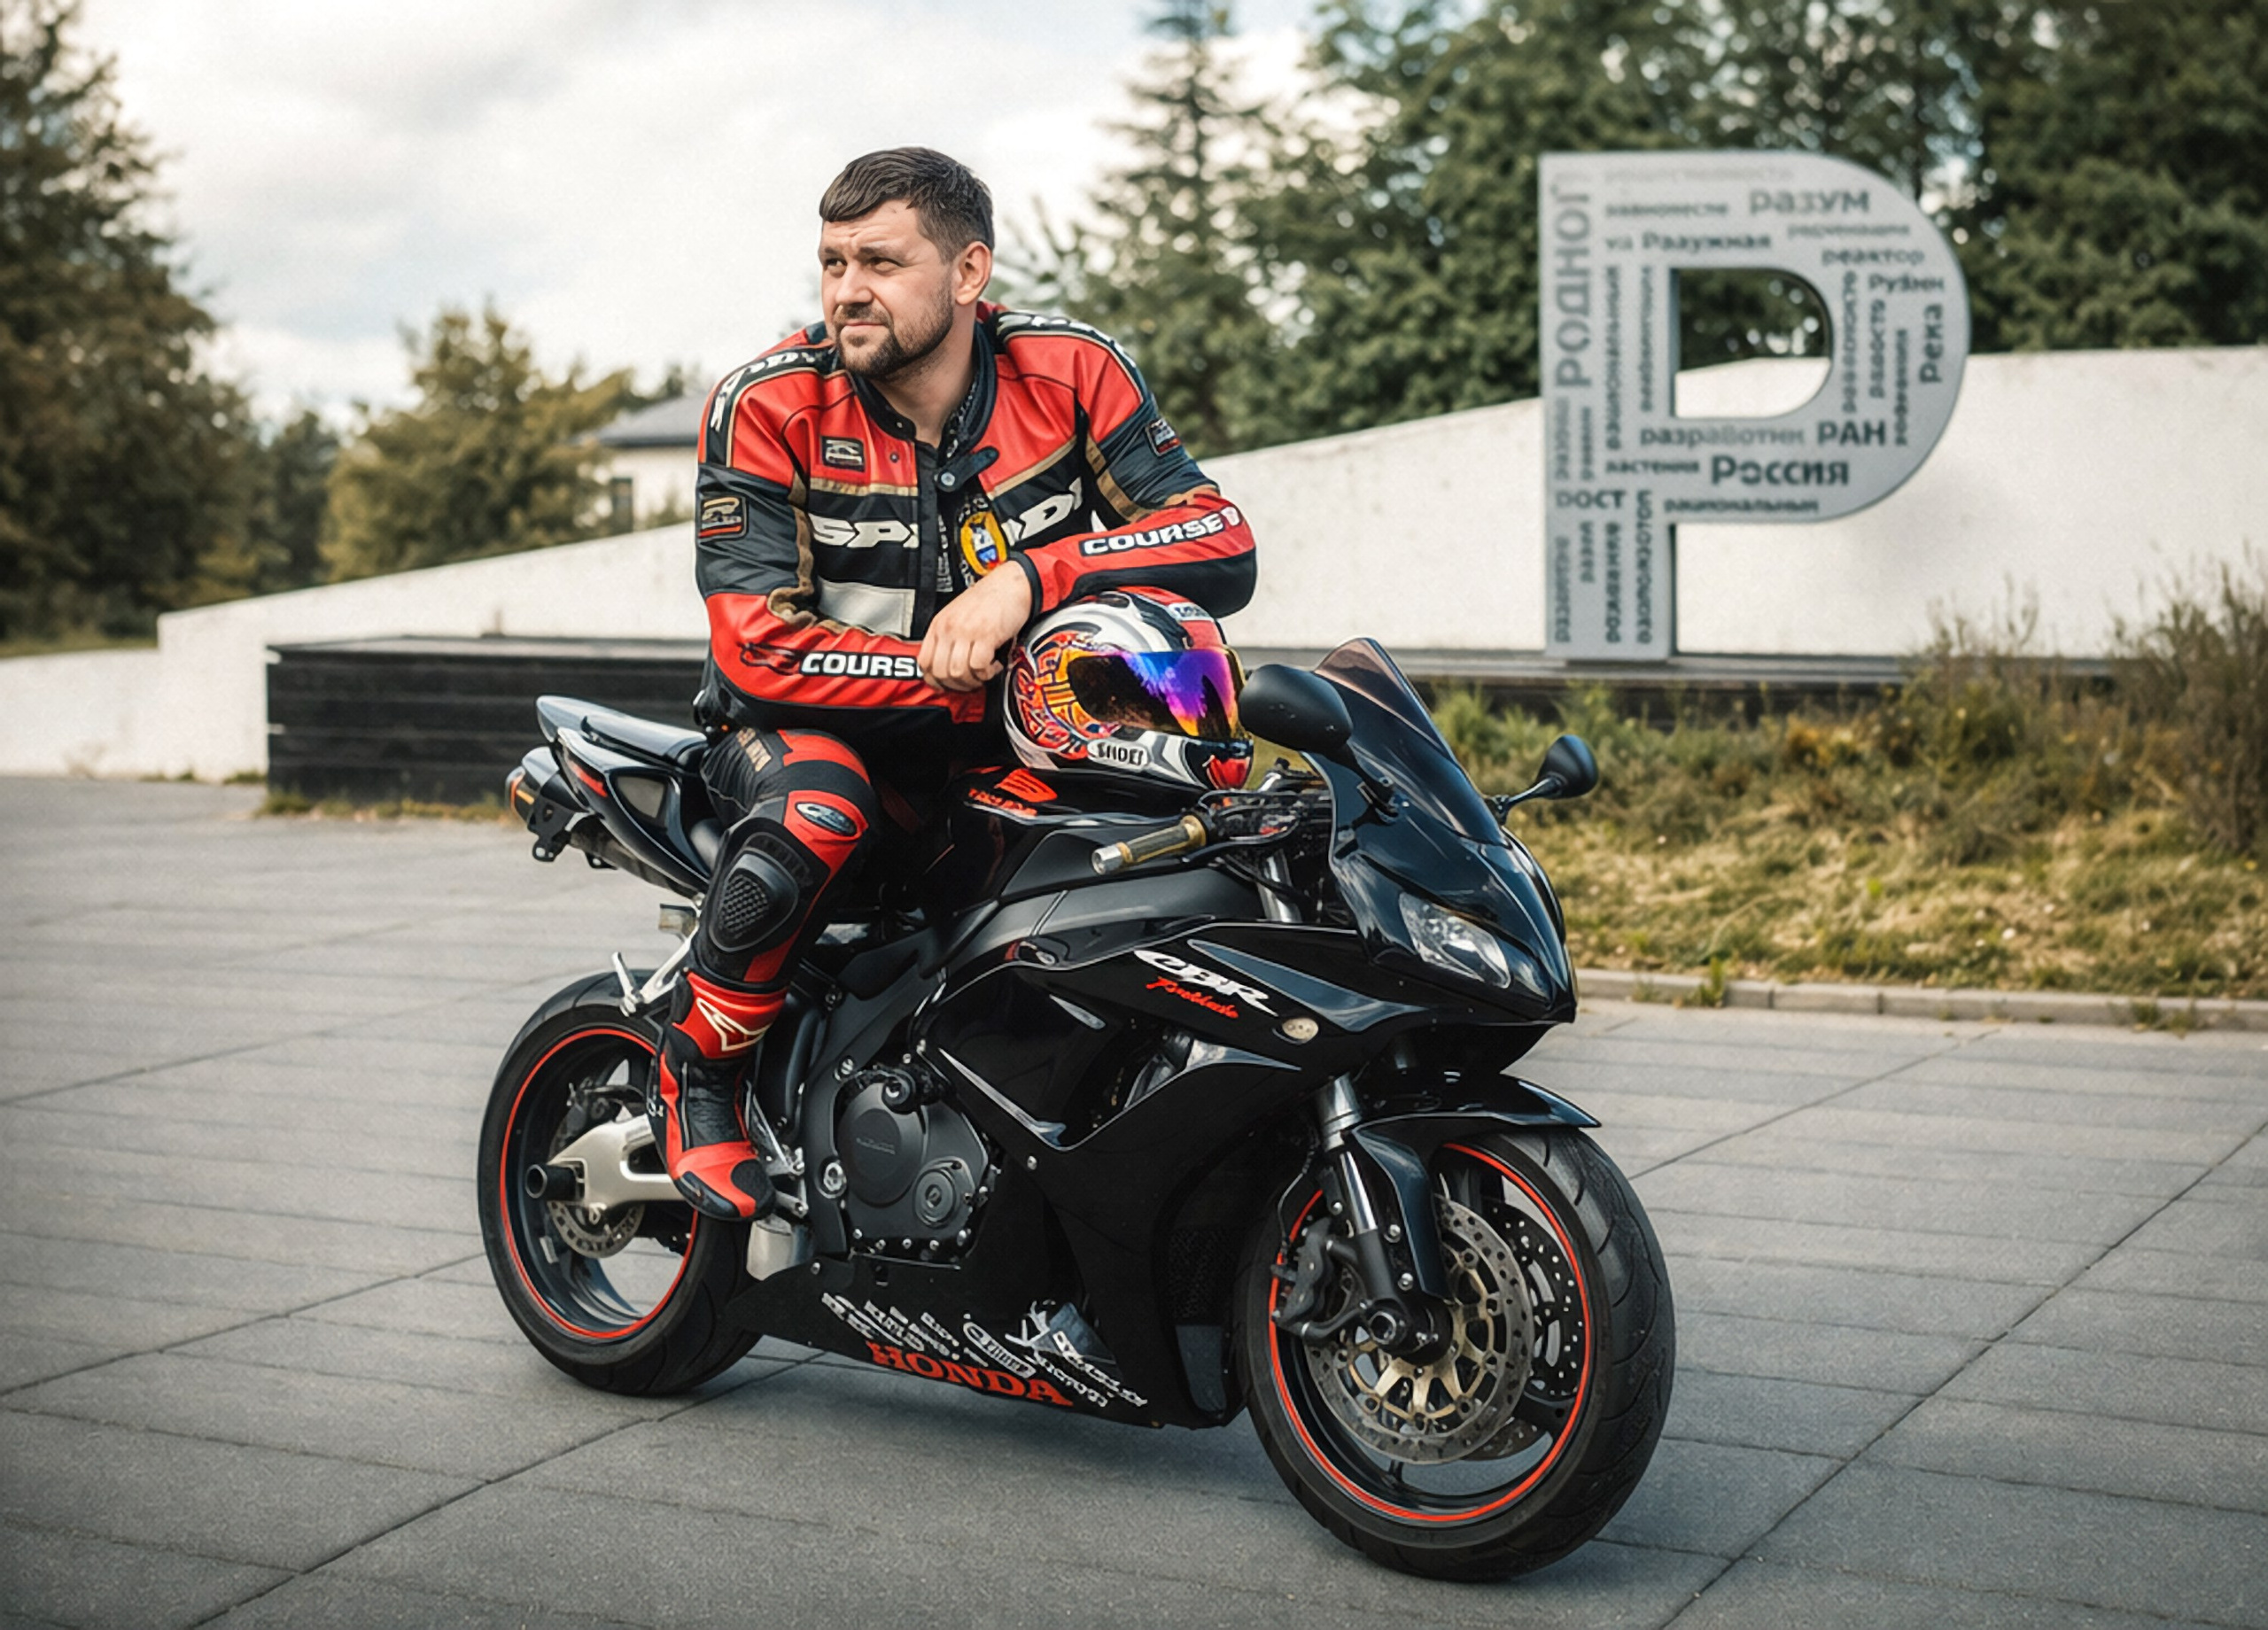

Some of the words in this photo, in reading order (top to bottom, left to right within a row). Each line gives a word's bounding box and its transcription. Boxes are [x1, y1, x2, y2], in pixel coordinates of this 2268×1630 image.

[1817, 420, 1886, 446] РАН
[1710, 454, 1850, 486] Россия
[800, 652, 925, 679] COURS
[866, 1339, 1074, 1408] HONDA
